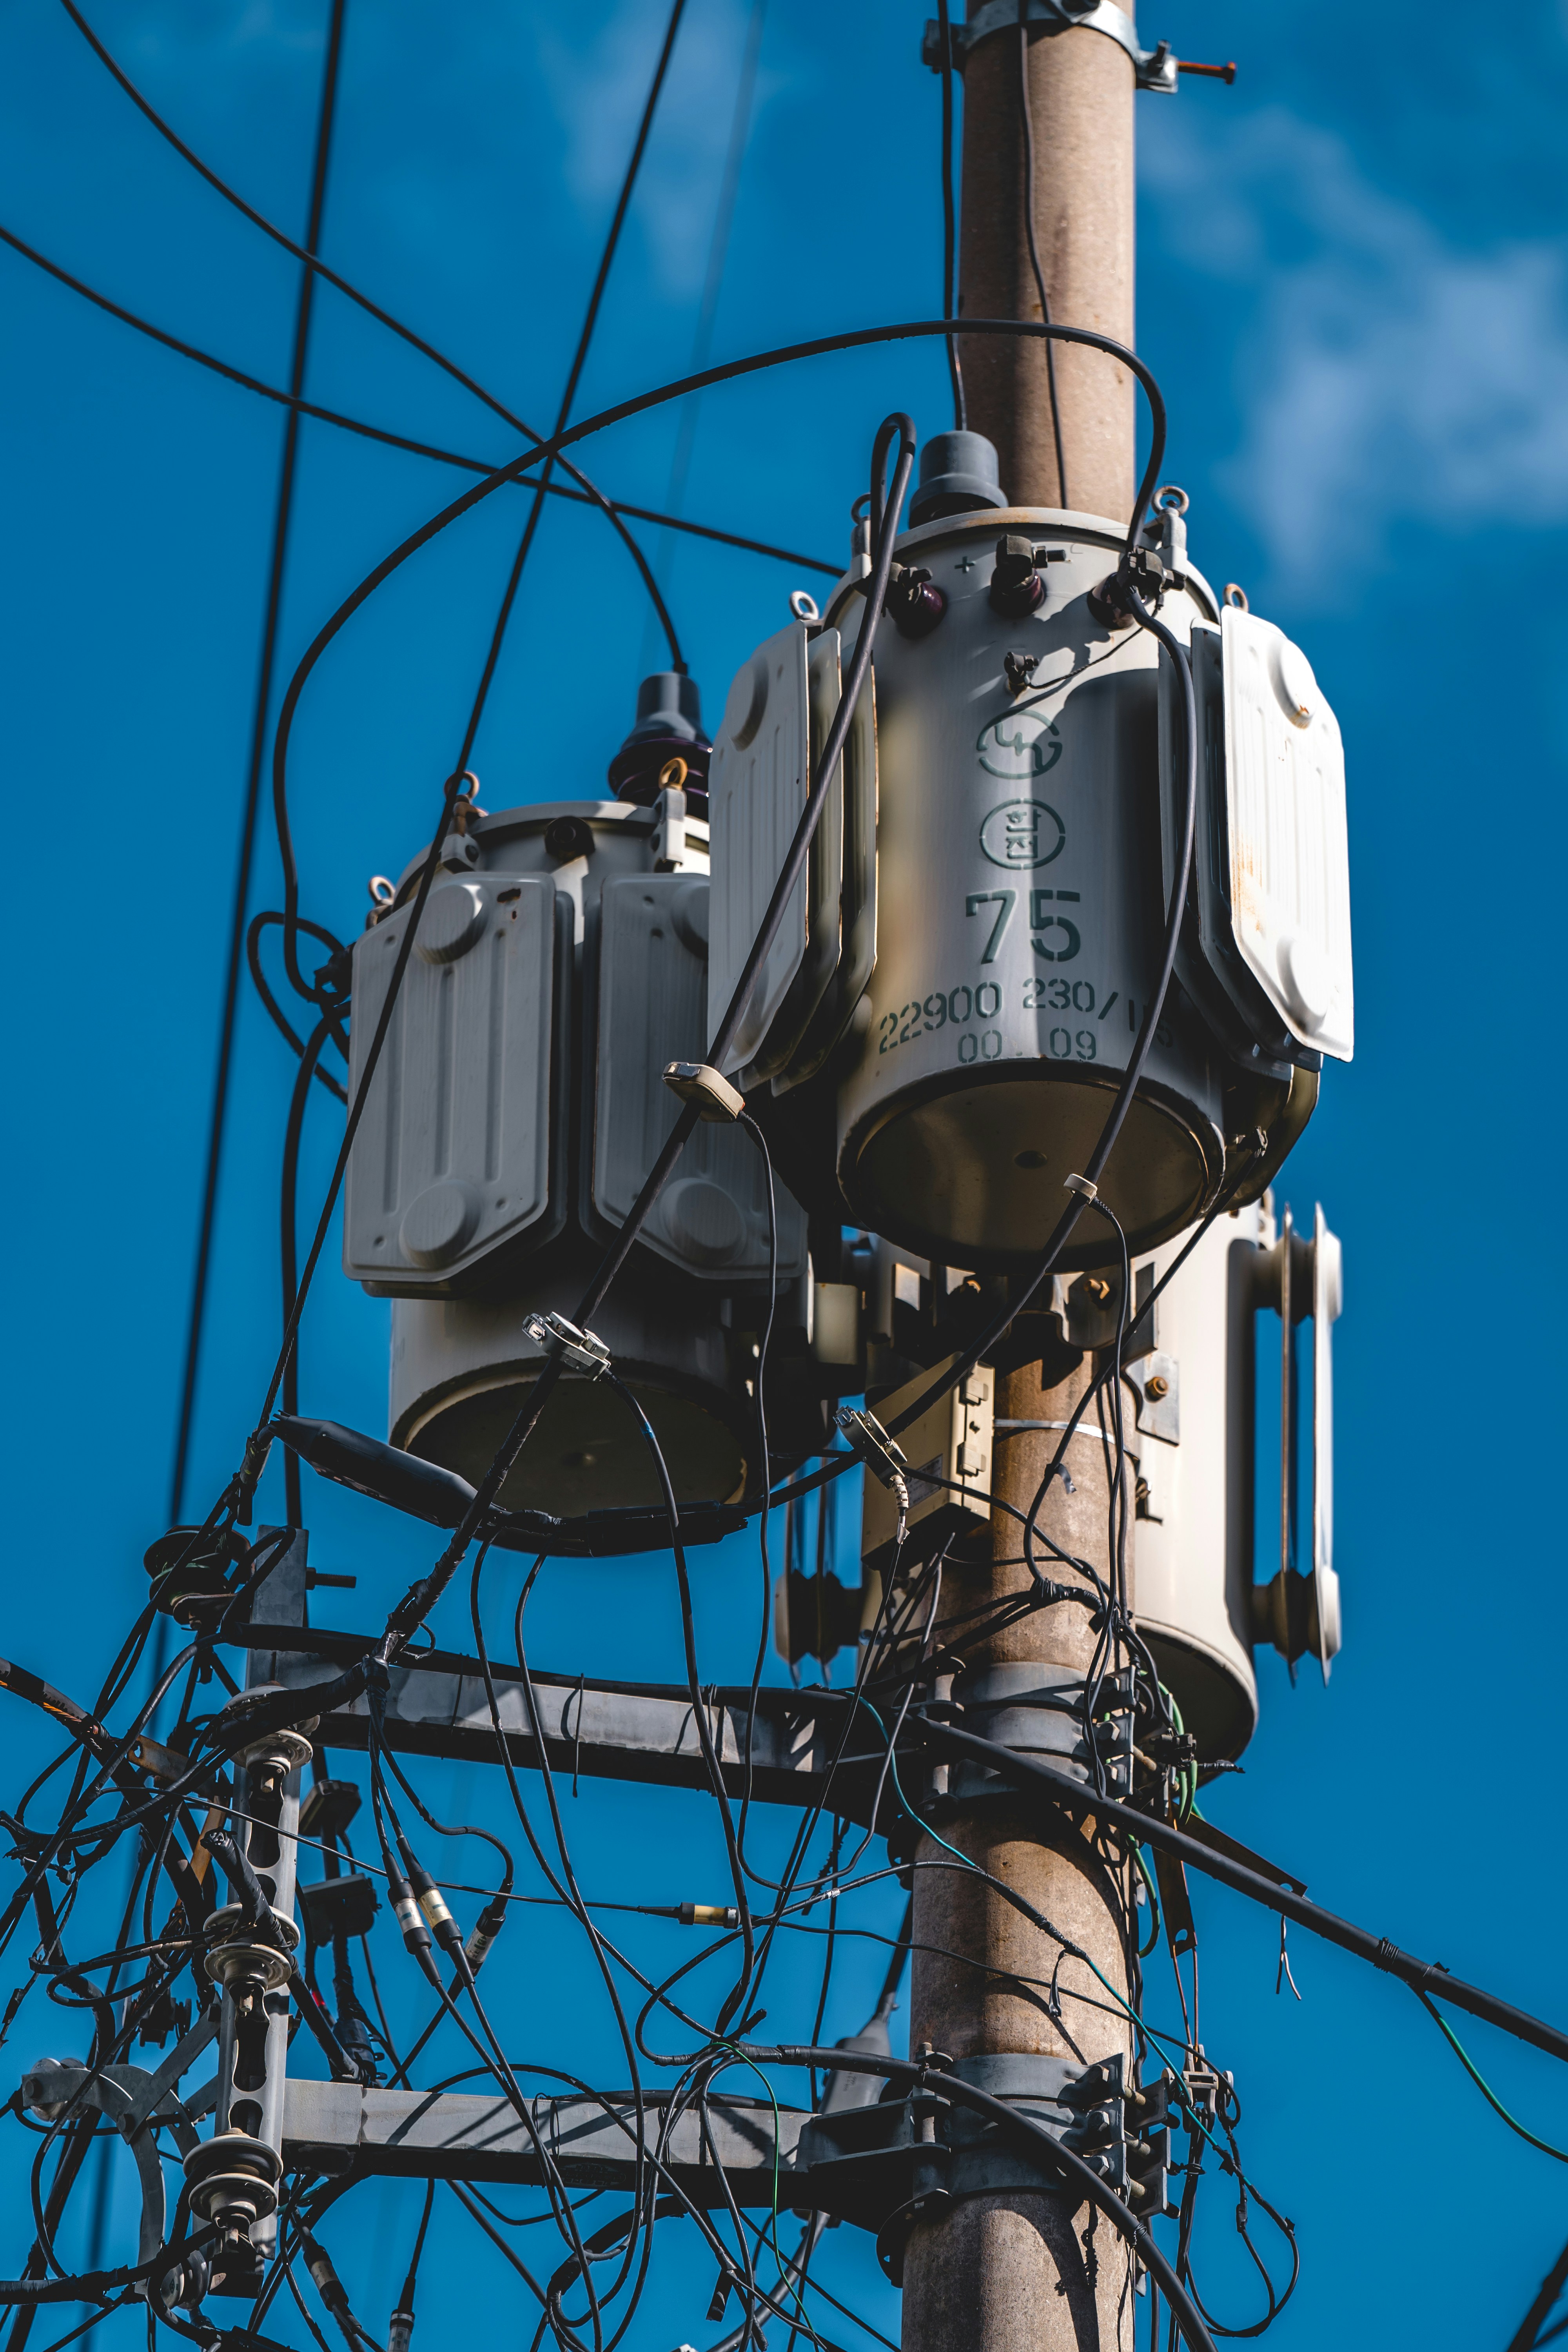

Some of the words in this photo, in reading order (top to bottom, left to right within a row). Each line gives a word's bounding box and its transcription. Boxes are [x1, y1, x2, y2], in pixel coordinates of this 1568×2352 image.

[1005, 809, 1042, 859] 한전
[965, 889, 1081, 964] 75
[879, 981, 1002, 1054] 22900
[1022, 978, 1173, 1048] 230/15
[1049, 1027, 1096, 1060] 09
